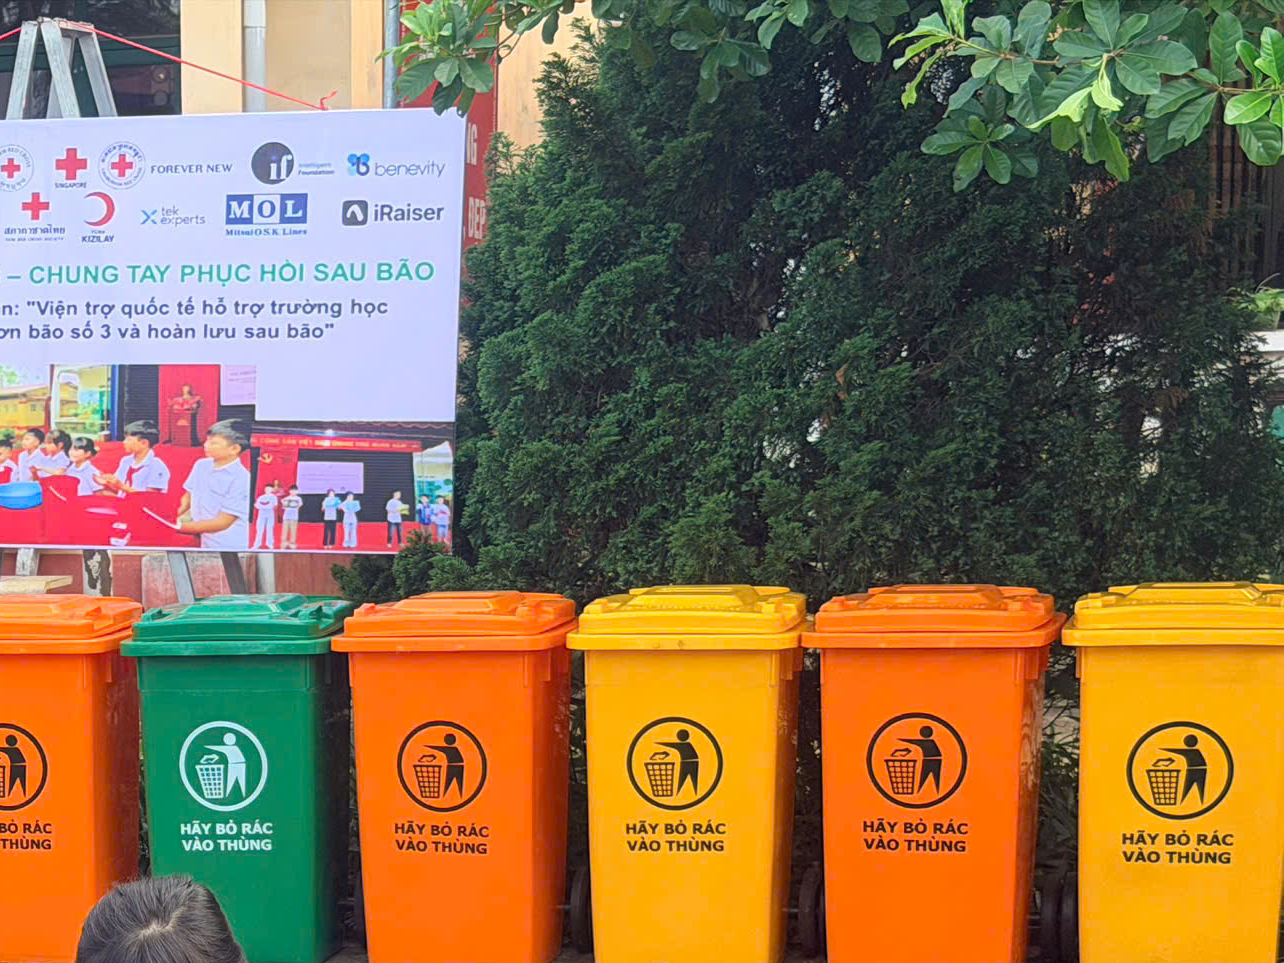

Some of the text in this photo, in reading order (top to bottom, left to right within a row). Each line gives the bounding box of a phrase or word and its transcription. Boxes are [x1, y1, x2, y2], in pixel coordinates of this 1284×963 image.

[150, 163, 233, 174] FOREVER NEW
[375, 160, 446, 178] benevity
[161, 205, 179, 216] tek
[228, 200, 303, 218] MOL
[374, 204, 444, 222] iRaiser
[160, 215, 206, 227] experts
[282, 227, 307, 235] Lines
[29, 265, 119, 284] CHUNG
[127, 264, 171, 283] TAY
[180, 263, 251, 287] PHỤC
[313, 262, 366, 282] SAU
[376, 258, 434, 281] BÃO
[27, 300, 77, 319] "Viện
[85, 301, 115, 319] trợ
[121, 296, 170, 319] quốc
[177, 296, 195, 315] tế
[202, 297, 227, 315] hỗ
[234, 301, 265, 318] trợ
[271, 299, 342, 318] trường
[351, 299, 388, 317] học
[29, 324, 64, 339] bão
[70, 320, 94, 339] số
[101, 324, 111, 339] 3
[117, 323, 140, 338] và
[147, 323, 196, 339] hoàn
[204, 323, 236, 339] lưu
[244, 326, 279, 338] sau
[23, 819, 52, 834] RÁC
[180, 819, 273, 835] HÃY BỎ RÁC
[394, 820, 489, 838] HÃY BỎ RÁC
[626, 819, 726, 835] HÃY BỎ RÁC
[863, 818, 968, 835] HÃY BỎ RÁC
[0, 836, 52, 850] THÙNG
[181, 836, 272, 851] VÀO THÙNG
[395, 836, 487, 854] VÀO THÙNG
[627, 836, 725, 852] VÀO THÙNG
[863, 835, 966, 852] VÀO THÙNG
[1122, 829, 1234, 846] HÃY BỎ RÁC
[1122, 847, 1231, 864] VÀO THÙNG
